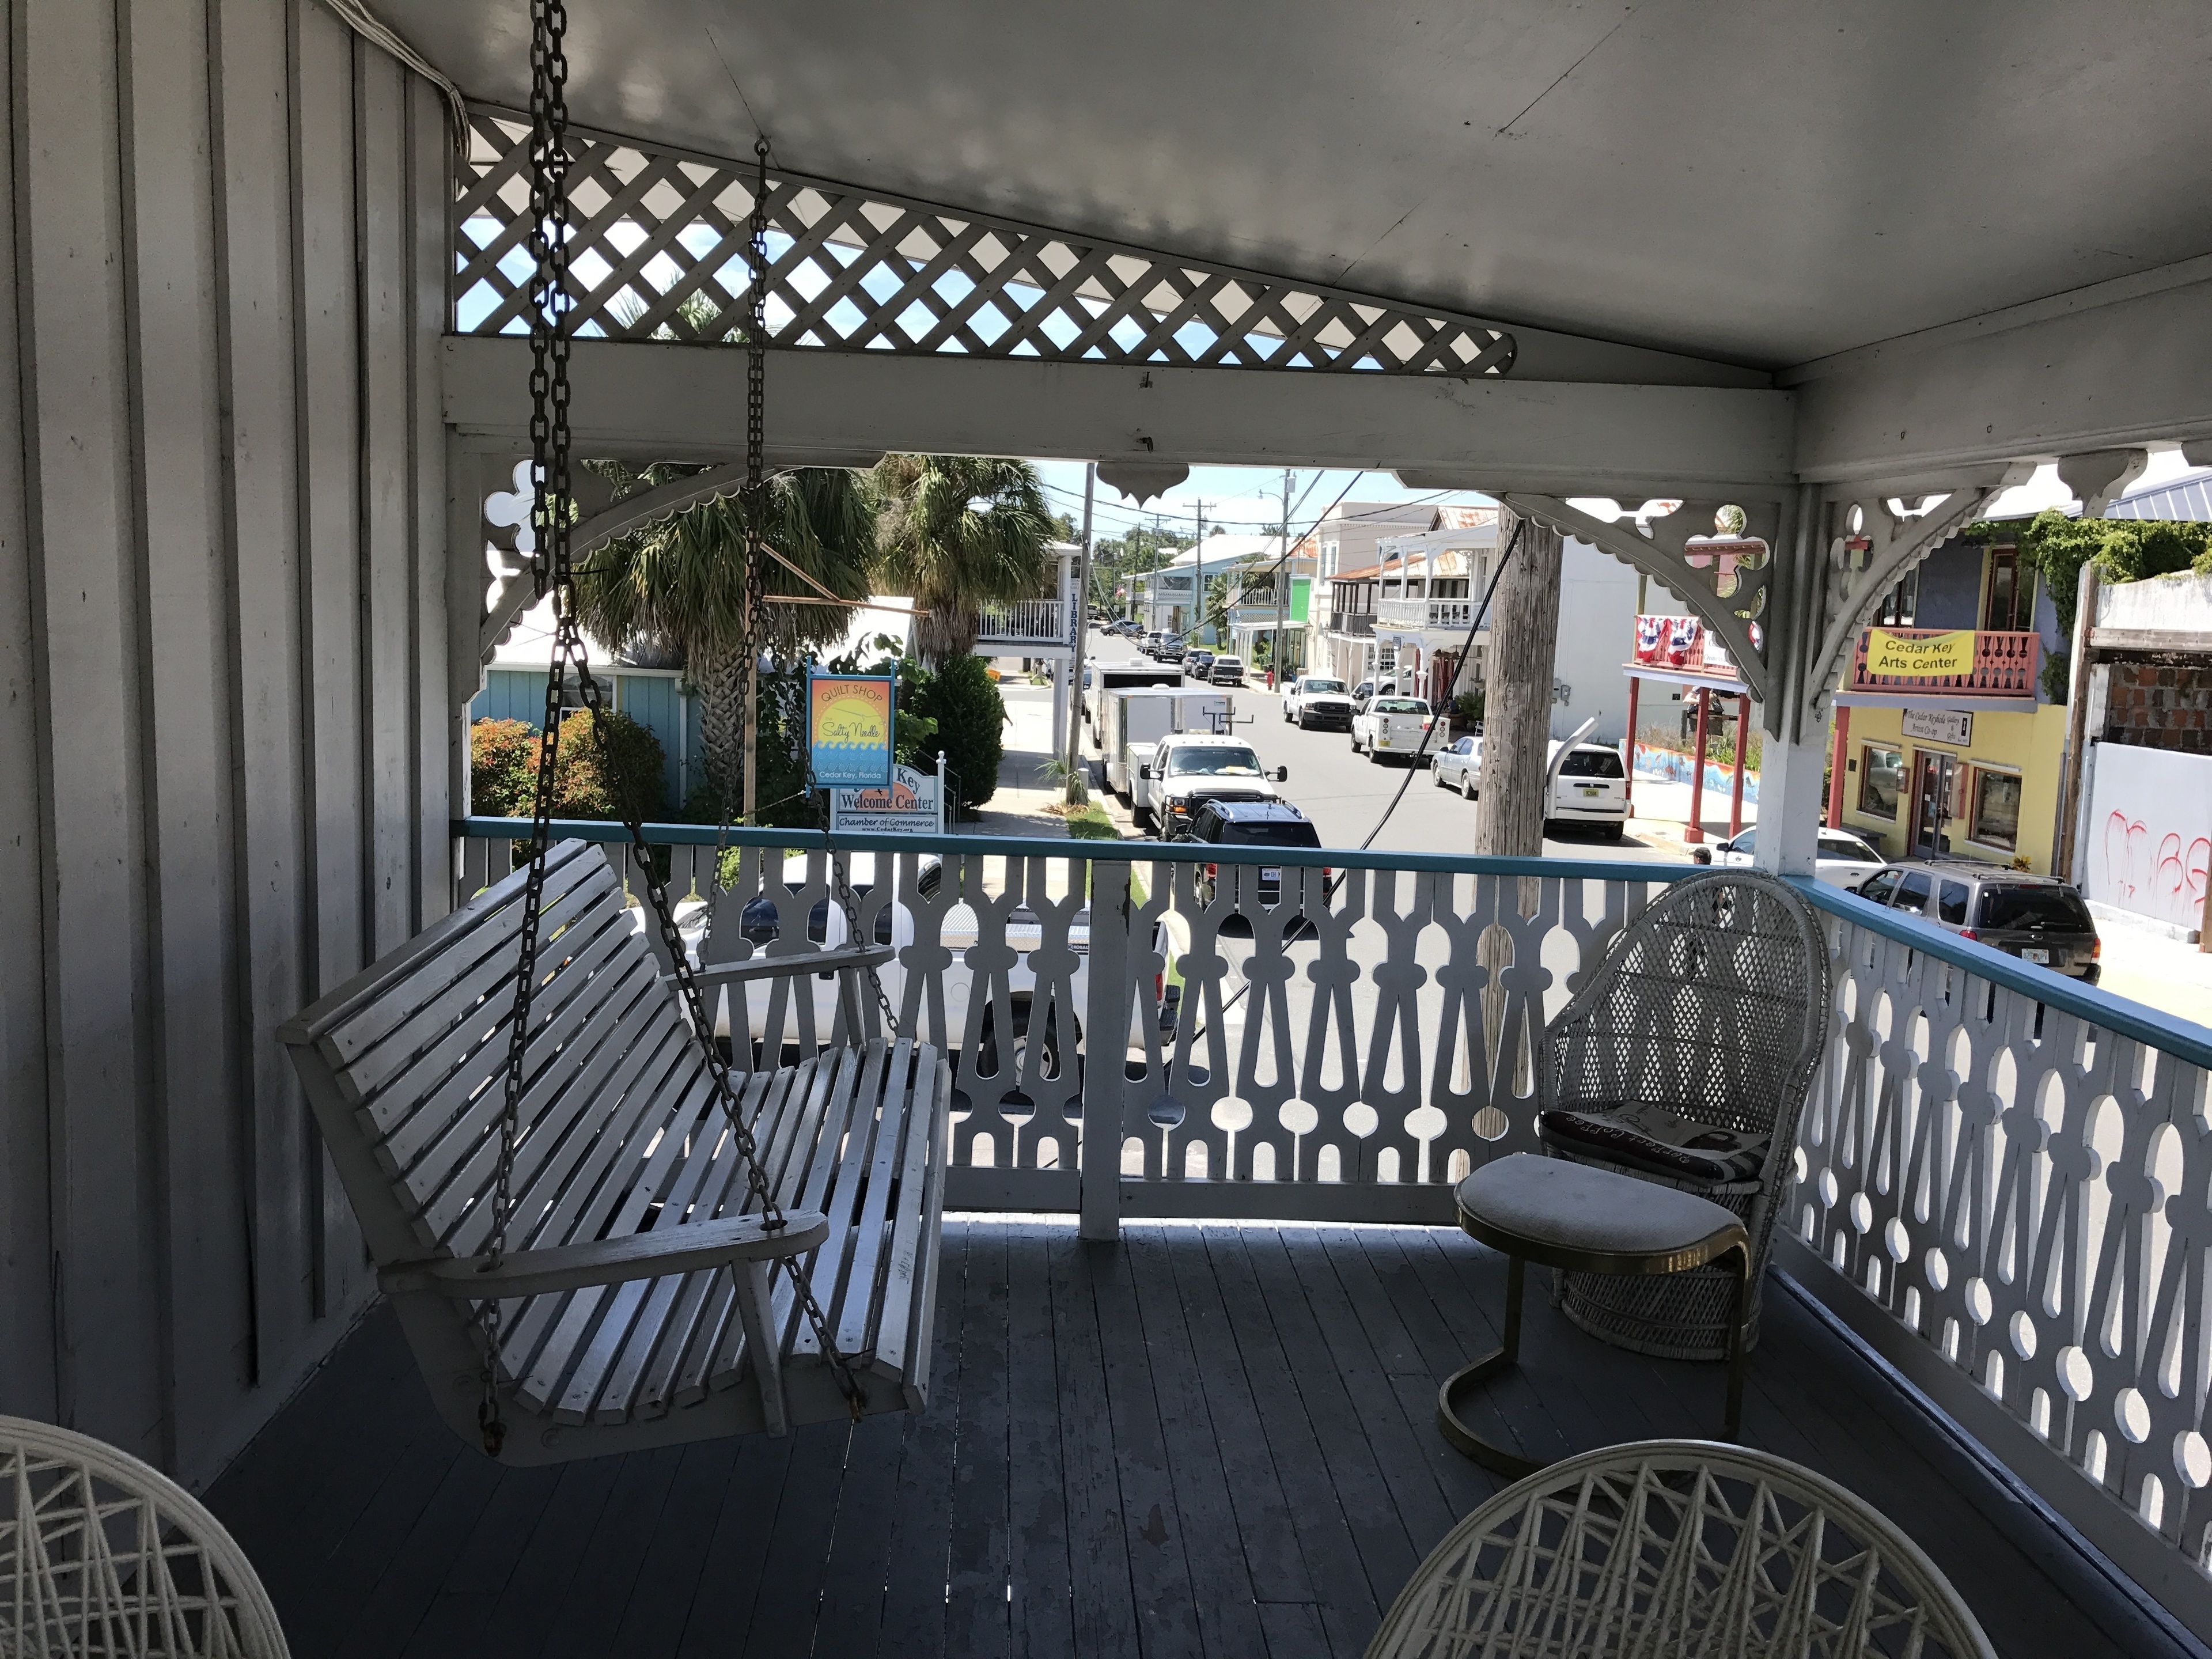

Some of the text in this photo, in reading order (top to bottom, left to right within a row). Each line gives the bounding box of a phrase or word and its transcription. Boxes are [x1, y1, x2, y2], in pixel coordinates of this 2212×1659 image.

[1069, 593, 1078, 652] LIBRARY
[1885, 640, 1955, 654] Cedar Key
[1878, 656, 1957, 669] Arts Center
[821, 684, 882, 702] QUILT SHOP
[822, 722, 880, 743] Salty Needle
[896, 767, 921, 795] Key
[841, 794, 934, 810] Welcome Center
[839, 817, 934, 827] Chamber of Commerce
